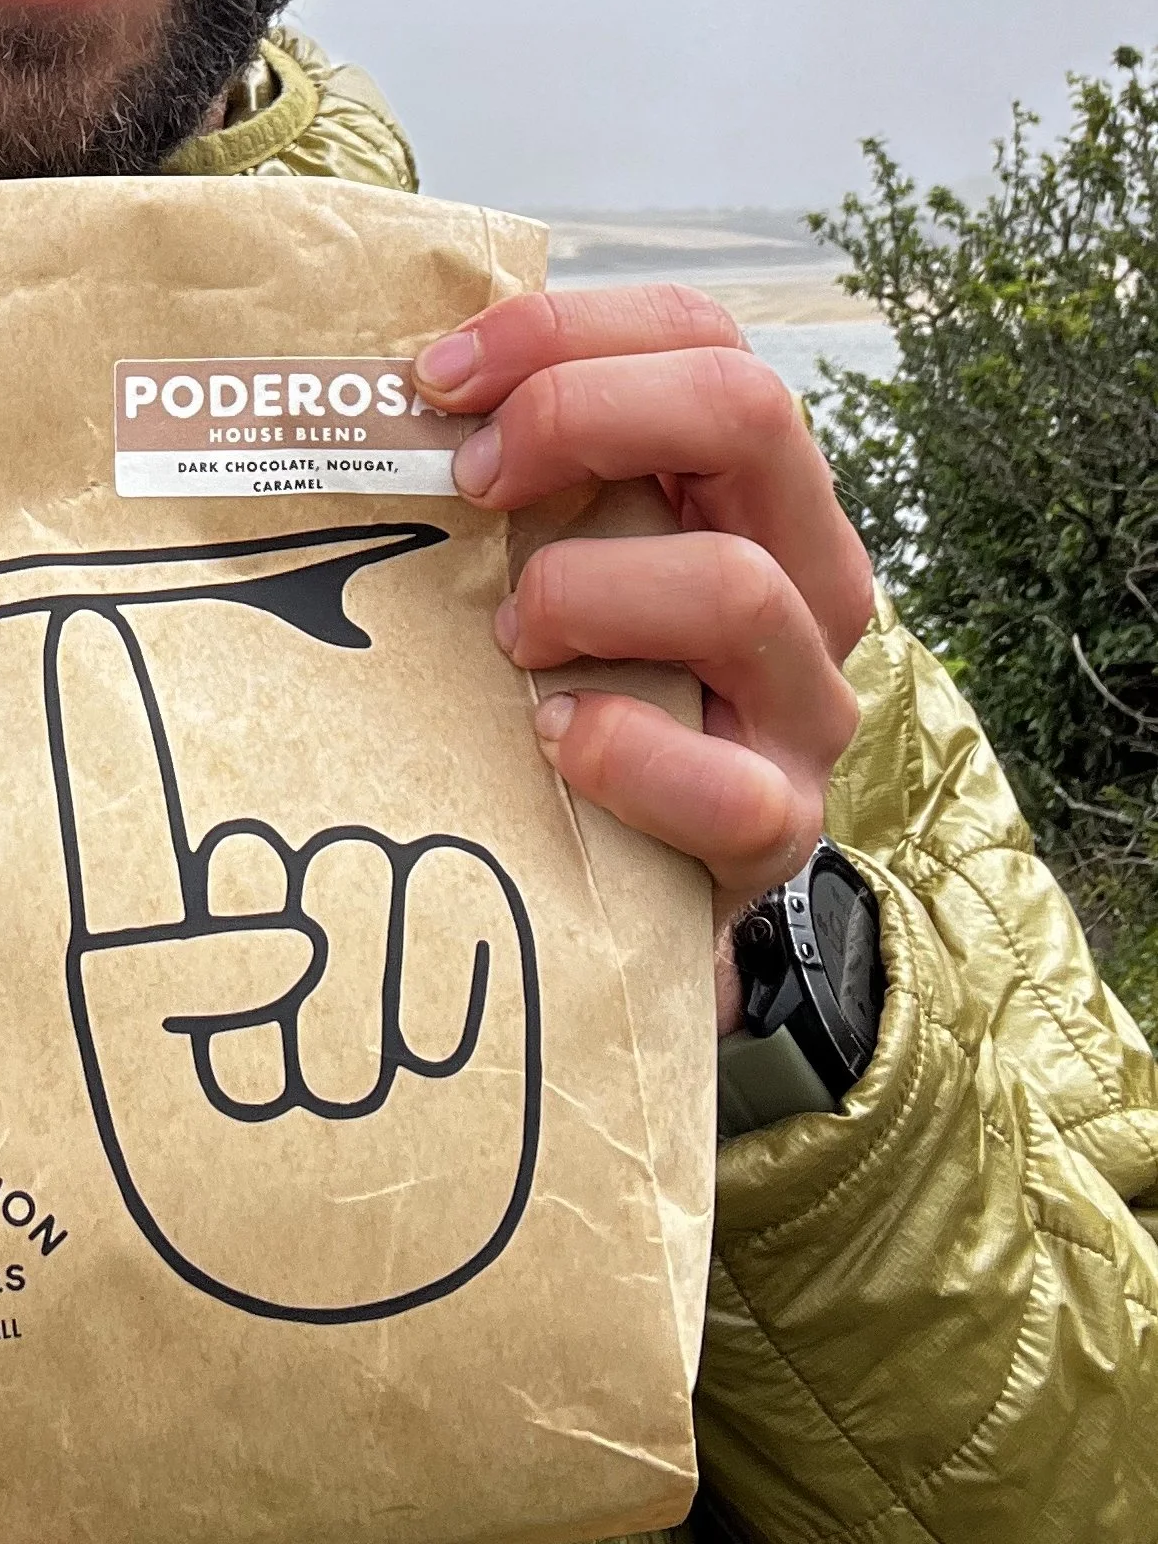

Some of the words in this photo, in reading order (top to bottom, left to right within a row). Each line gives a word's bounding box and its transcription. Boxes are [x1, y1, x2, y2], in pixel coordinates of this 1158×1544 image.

[209, 427, 284, 443] HOUSE
[296, 427, 367, 443] BLEND
[178, 461, 218, 473] DARK
[225, 459, 321, 473] CHOCOLATE,
[327, 460, 399, 474] NOUGAT,
[253, 479, 324, 493] CARAMEL
